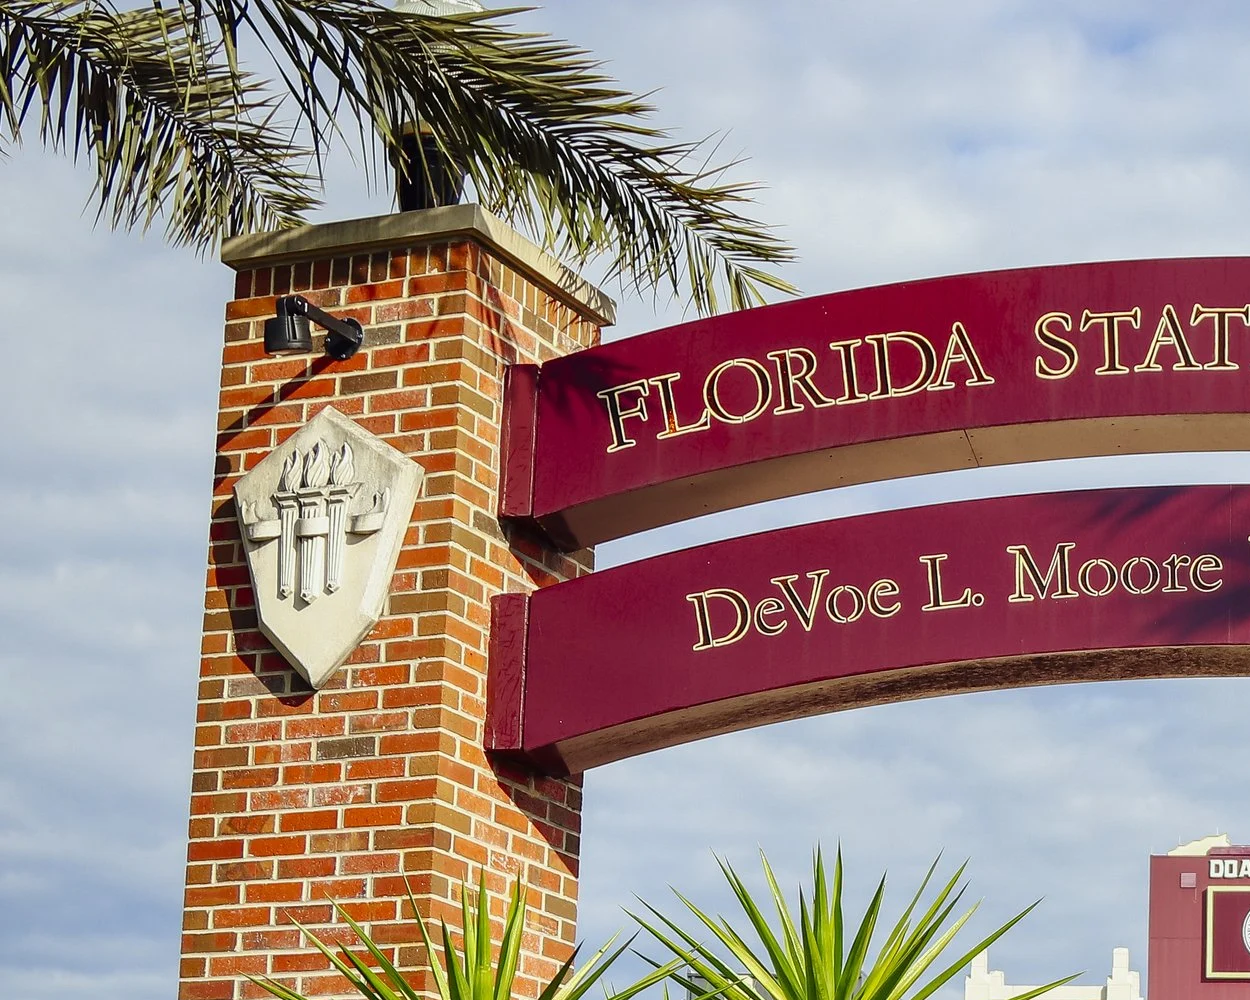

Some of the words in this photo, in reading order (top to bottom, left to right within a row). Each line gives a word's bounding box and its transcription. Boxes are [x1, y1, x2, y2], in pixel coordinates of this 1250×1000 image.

[598, 321, 994, 453] FLORIDA
[686, 569, 901, 651] DeVoe
[919, 553, 985, 612] L.
[1007, 542, 1224, 603] Moore
